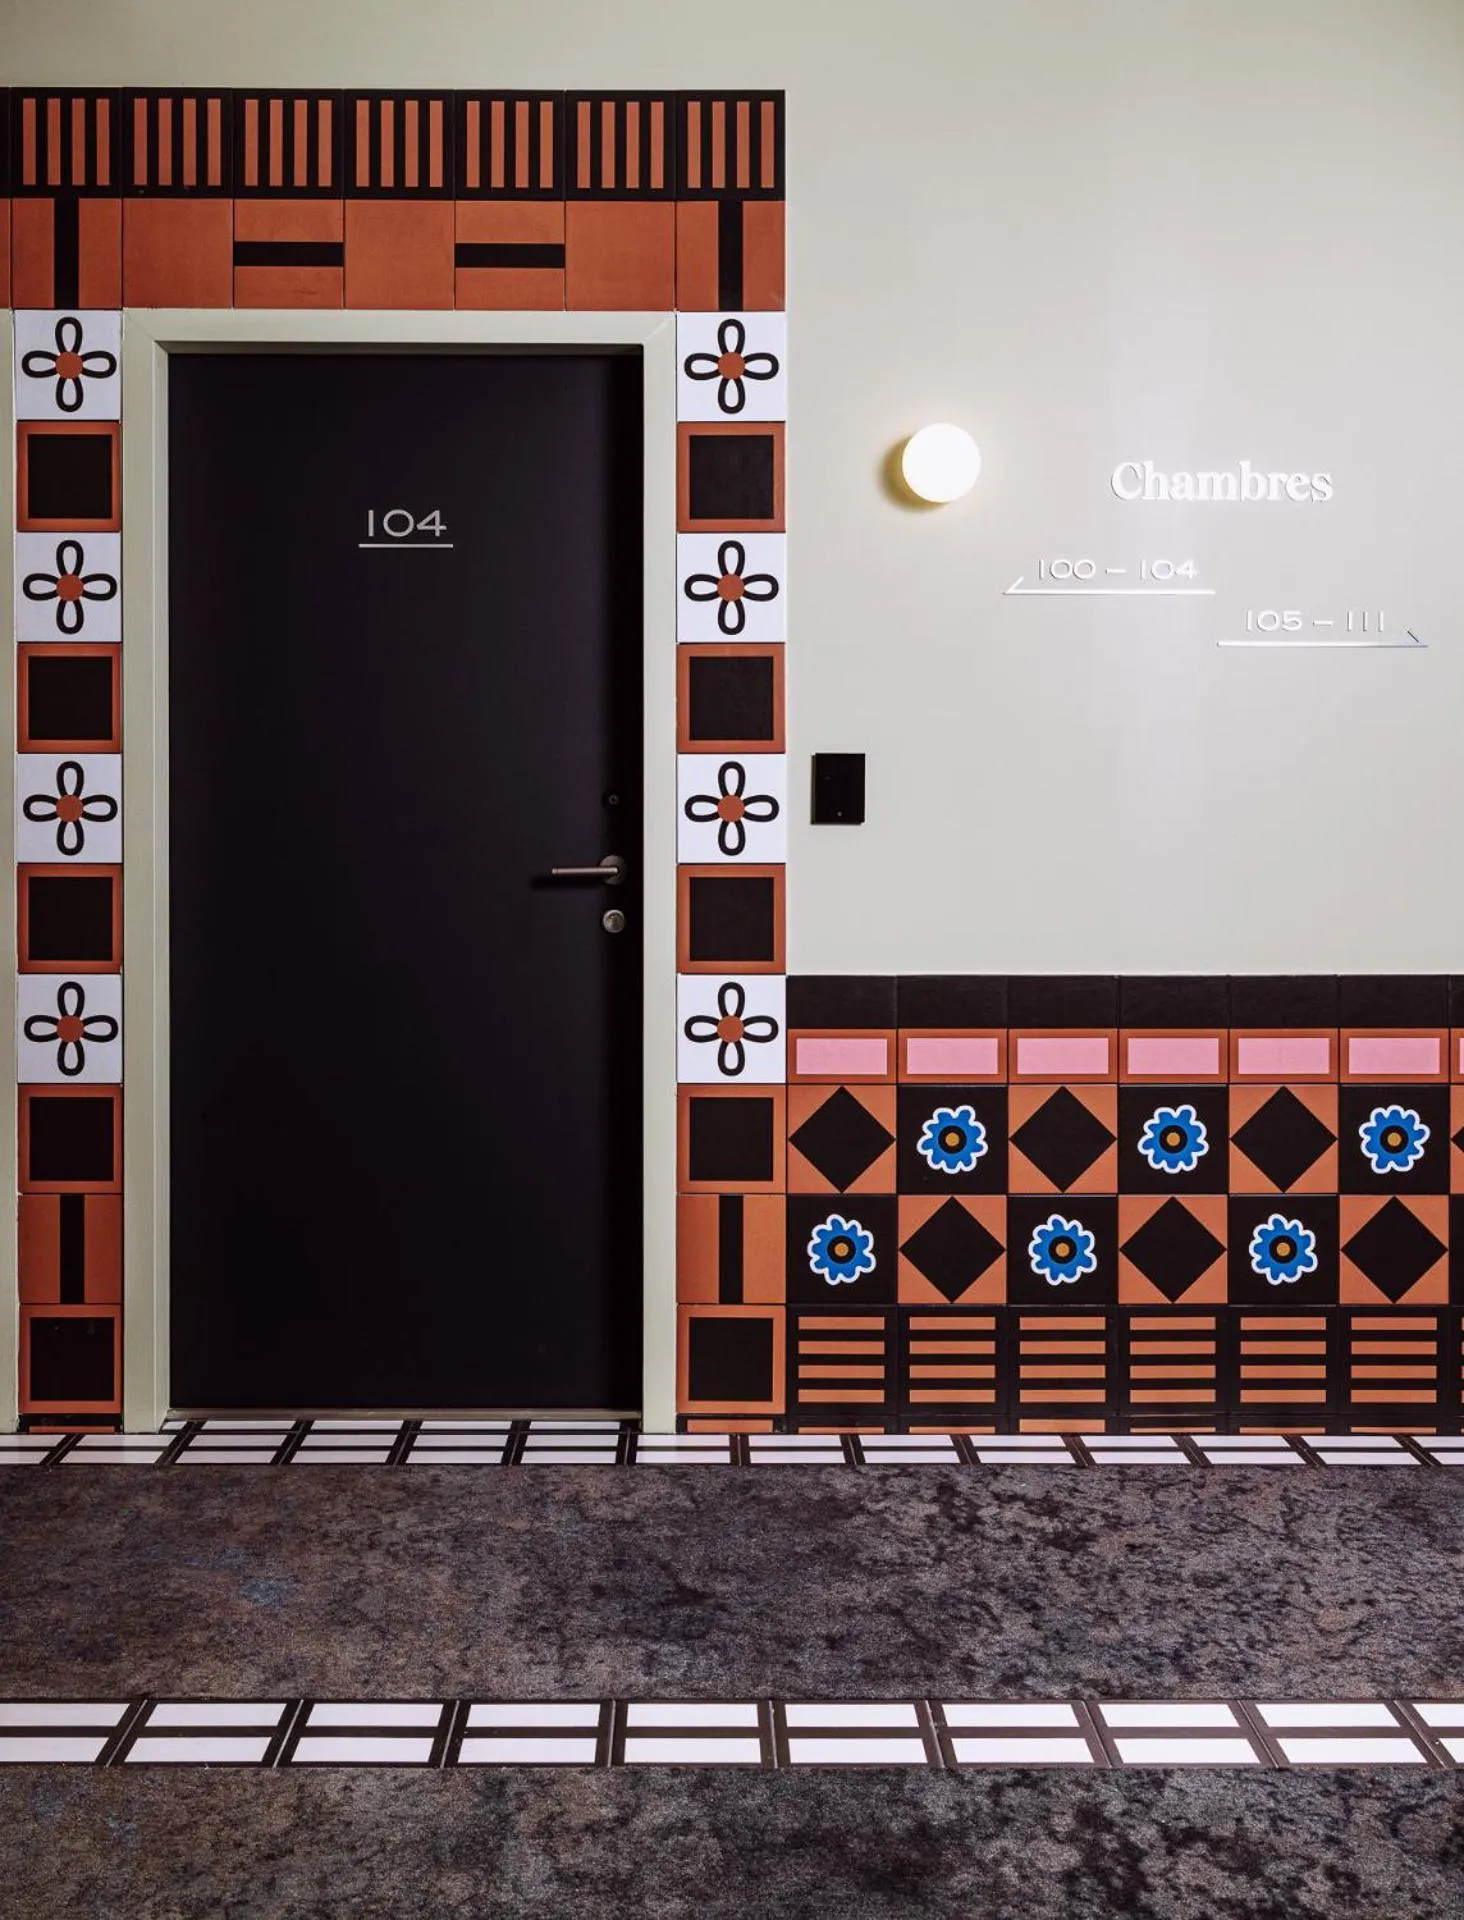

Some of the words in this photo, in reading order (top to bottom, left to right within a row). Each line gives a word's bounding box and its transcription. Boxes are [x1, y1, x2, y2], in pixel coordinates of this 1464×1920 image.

[1110, 460, 1335, 502] Chambres
[368, 508, 447, 537] 104
[1038, 559, 1096, 580] 100
[1140, 559, 1199, 580] 104
[1246, 610, 1302, 632] 105
[1346, 610, 1386, 632] 111
